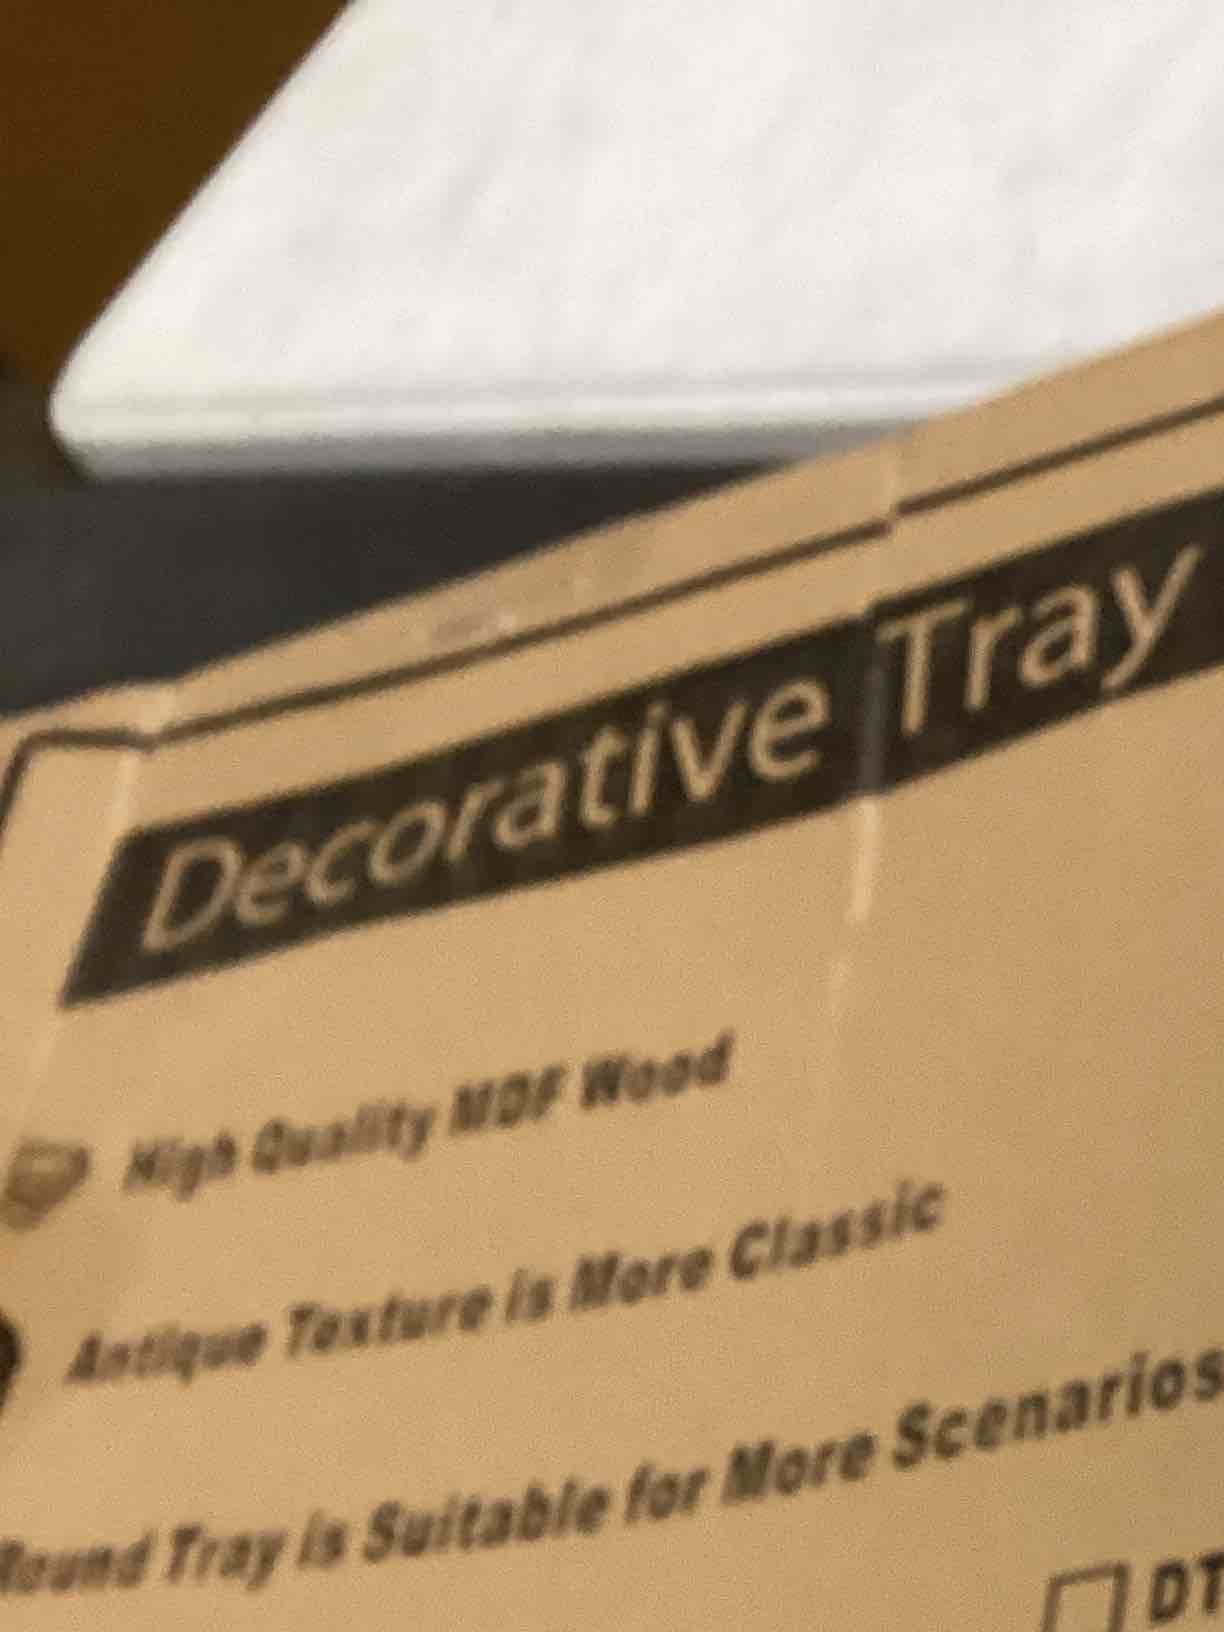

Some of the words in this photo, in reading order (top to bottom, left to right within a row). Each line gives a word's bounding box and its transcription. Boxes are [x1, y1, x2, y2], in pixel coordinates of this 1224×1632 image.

[139, 674, 830, 954] Decorative
[876, 540, 1204, 738] Tray
[122, 1129, 239, 1203] High
[250, 1099, 436, 1177] Quality
[578, 1027, 735, 1111] Wood
[62, 1320, 269, 1386] Antique
[284, 1285, 494, 1360] Texture
[504, 1267, 556, 1325] is
[569, 1244, 713, 1313] More
[727, 1178, 946, 1281] Classic
[166, 1521, 288, 1592] Tray
[296, 1508, 348, 1573] is
[361, 1479, 612, 1565] Suitable
[624, 1459, 710, 1526] for
[719, 1428, 878, 1508] More
